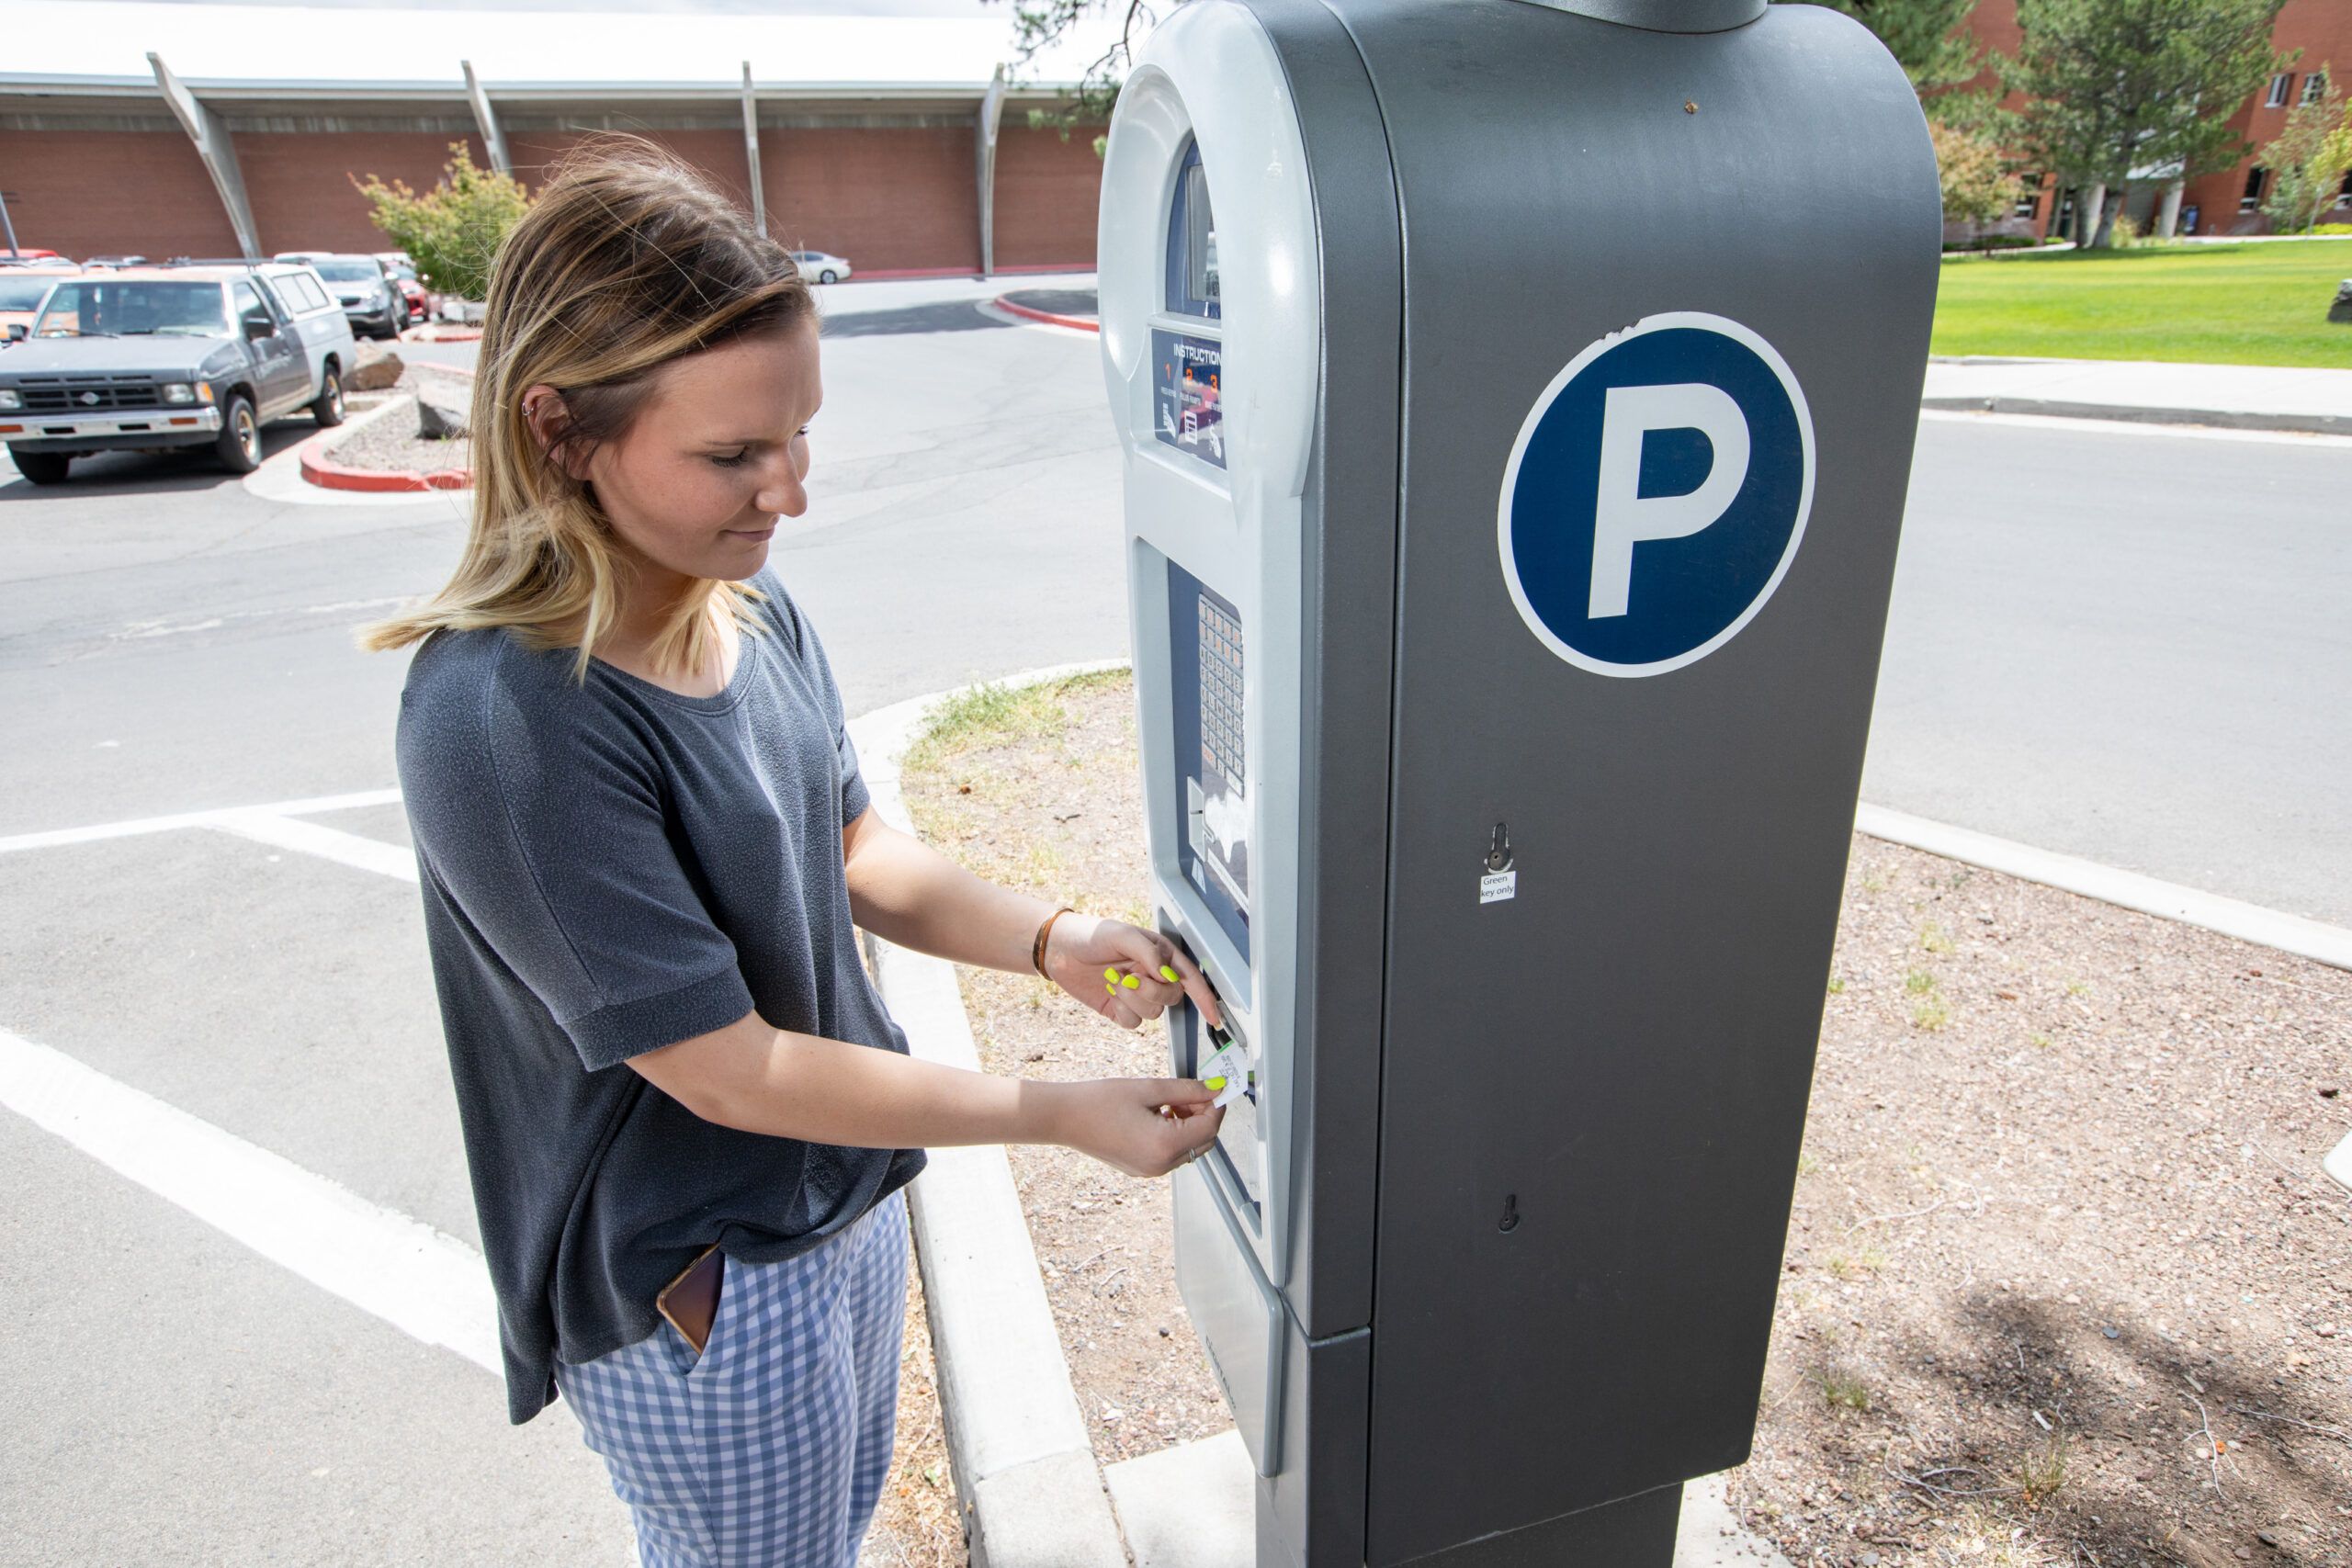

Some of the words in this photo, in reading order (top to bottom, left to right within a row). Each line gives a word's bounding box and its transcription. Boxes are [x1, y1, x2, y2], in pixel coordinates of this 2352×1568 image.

[1588, 382, 1750, 619] P
[1484, 875, 1508, 885] Green
[1481, 889, 1495, 897] key
[1496, 885, 1514, 895] only
